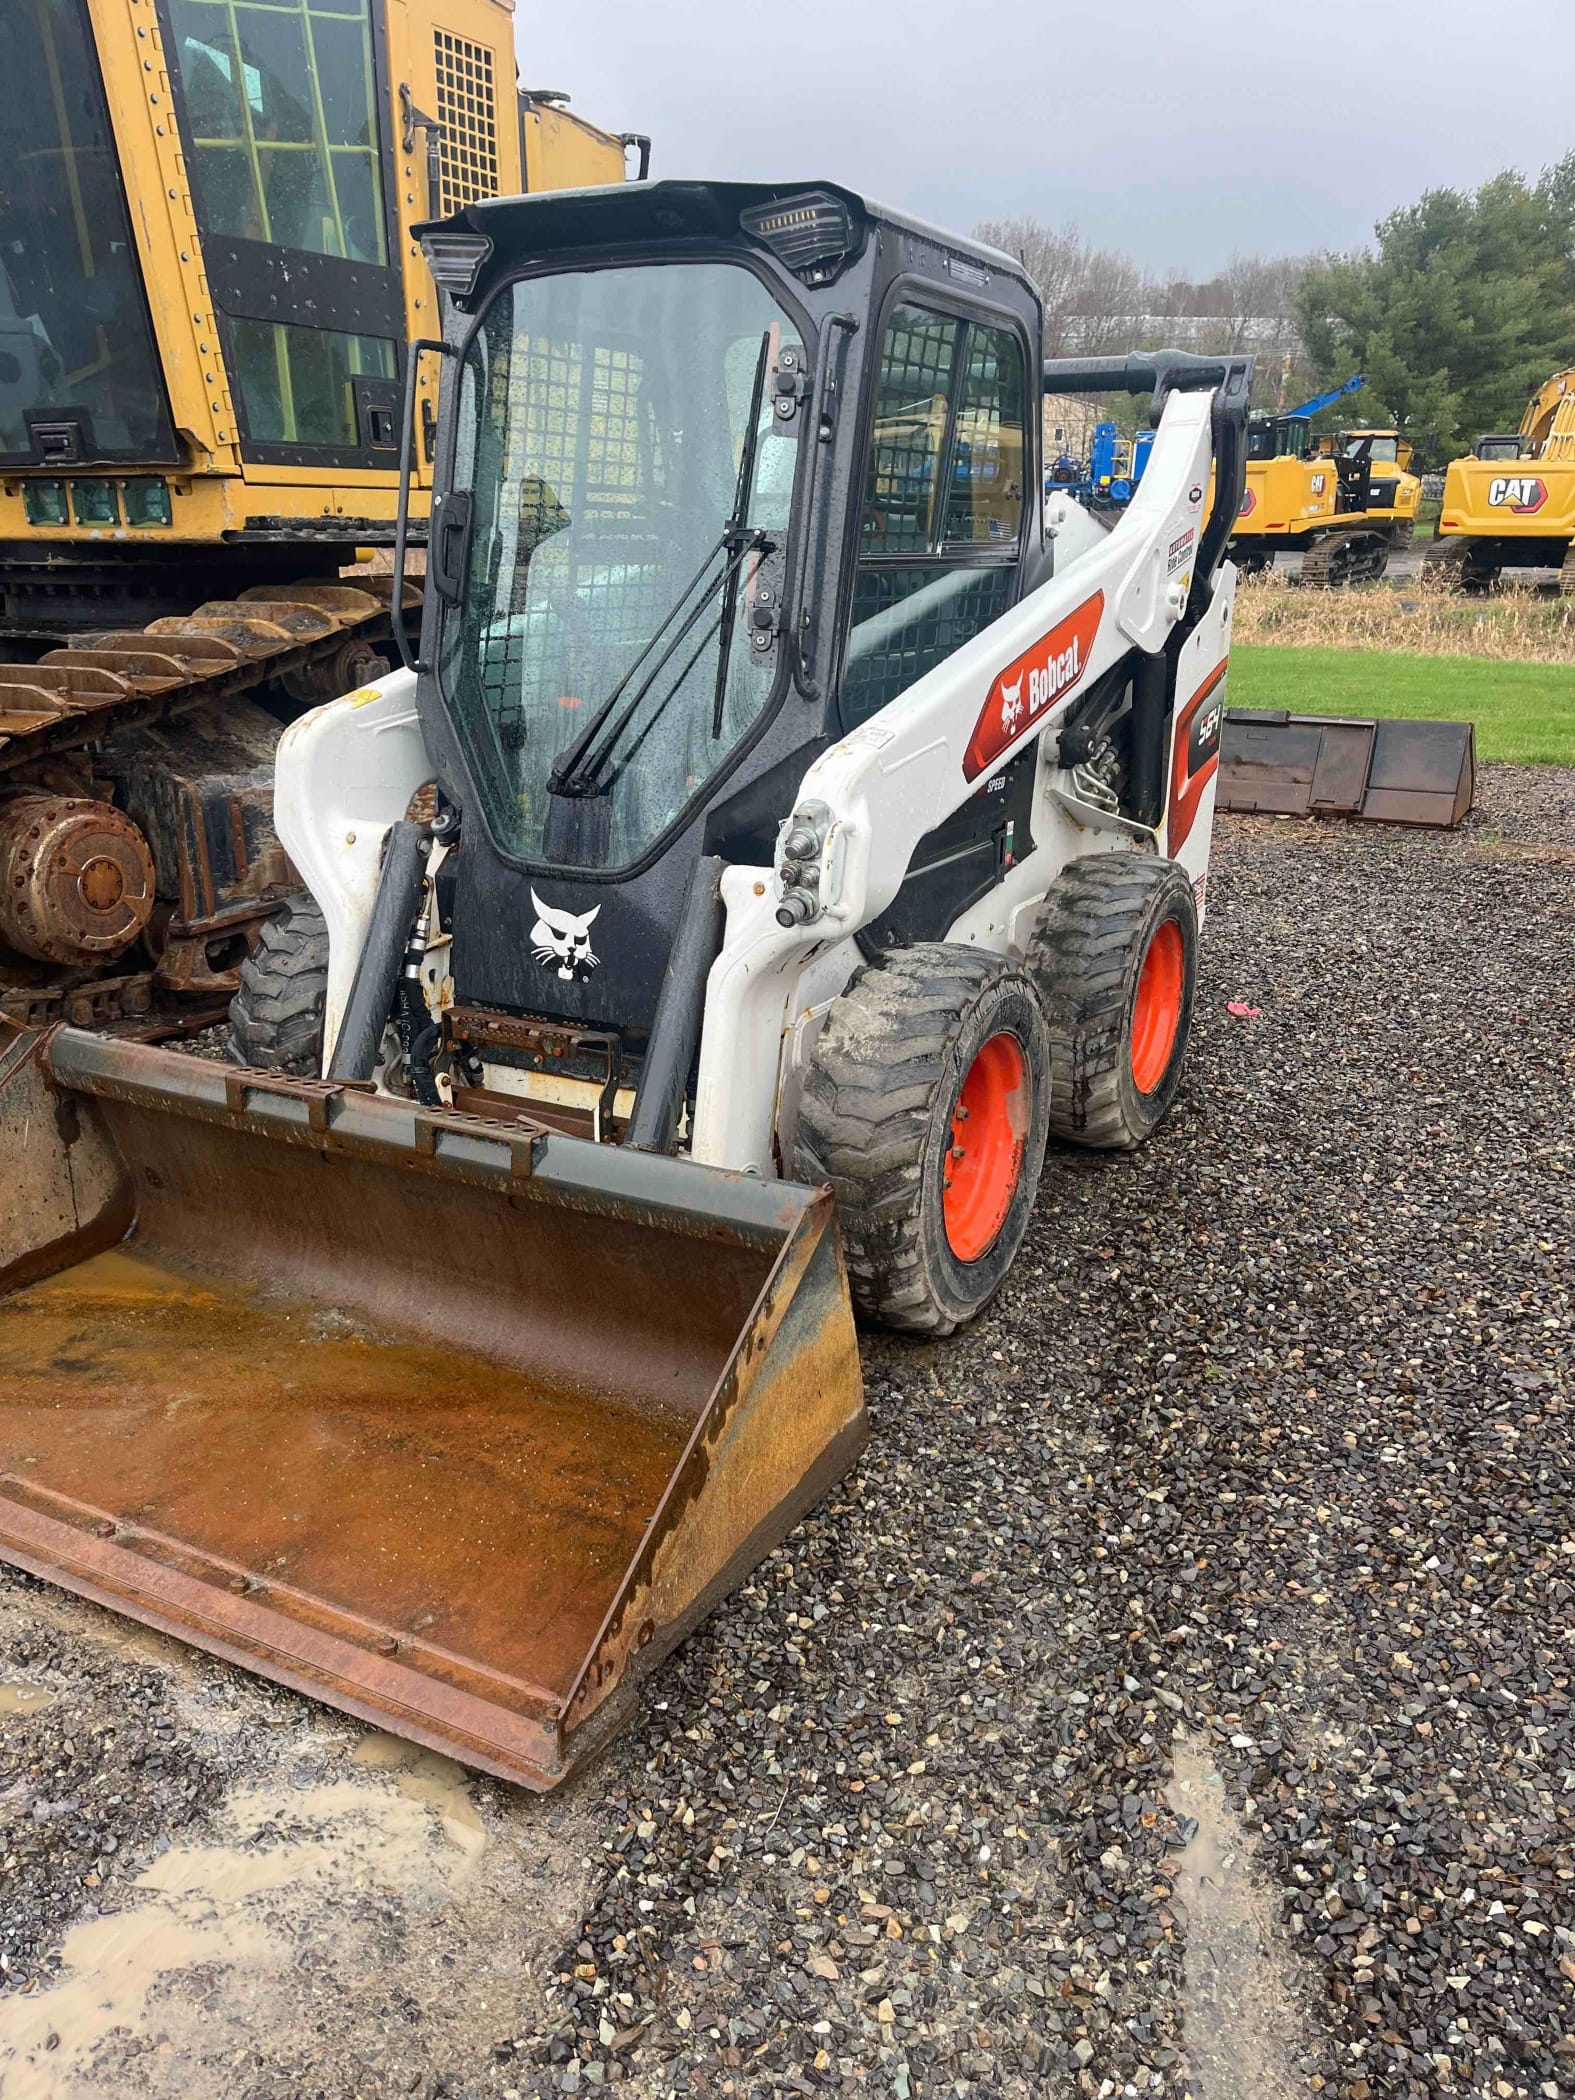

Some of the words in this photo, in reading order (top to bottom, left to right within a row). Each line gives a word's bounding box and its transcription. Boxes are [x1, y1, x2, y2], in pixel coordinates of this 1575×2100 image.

[1311, 474, 1325, 493] CAT
[1488, 478, 1536, 506] CAT
[1029, 634, 1079, 715] Bobcat
[1198, 703, 1221, 746] S64
[987, 776, 1006, 794] SPEED
